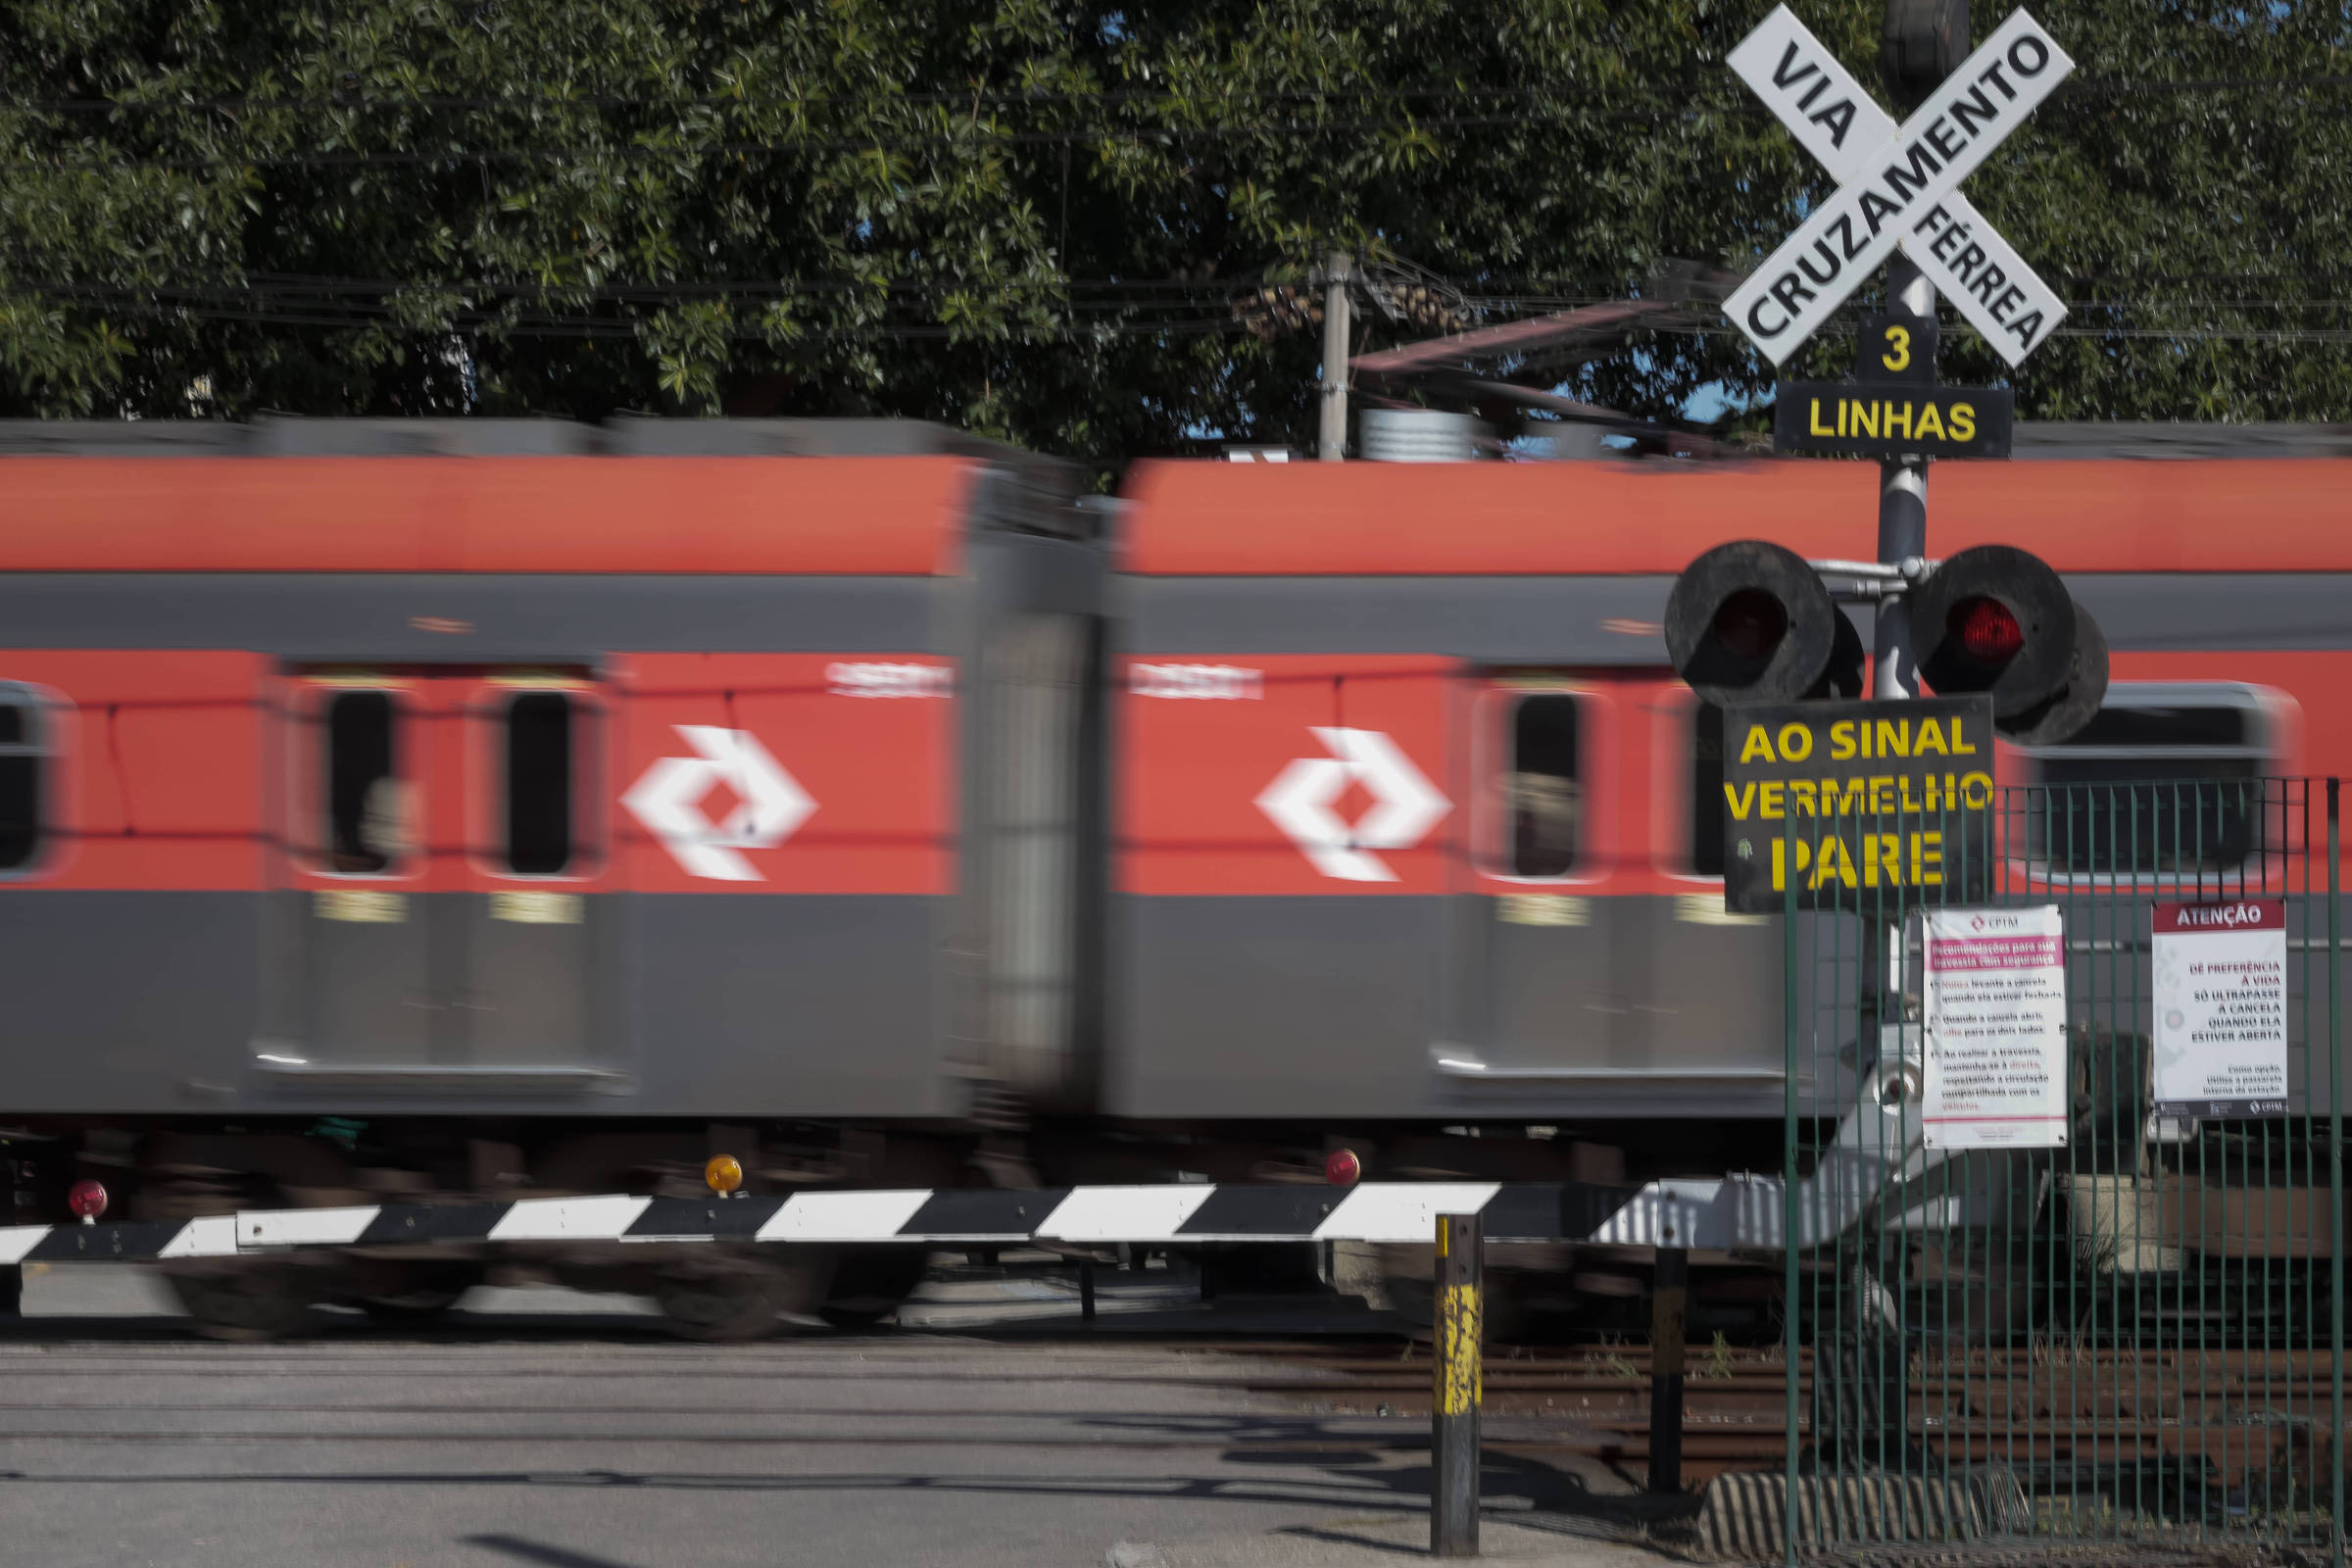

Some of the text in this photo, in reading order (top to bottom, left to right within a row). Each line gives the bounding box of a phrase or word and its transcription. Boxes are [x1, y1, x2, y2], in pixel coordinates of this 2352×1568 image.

[1771, 40, 1858, 150] VIA
[1747, 35, 2050, 340] CRUZAMENTO
[1913, 203, 2044, 352] FÉRREA
[1882, 325, 1911, 372] 3
[1810, 398, 1977, 442] LINHAS
[1740, 716, 1977, 764] AO SINAL
[1724, 771, 1994, 820] VERMELHO
[1771, 831, 1948, 893] PARE
[2177, 902, 2263, 928] ATENÇÃO
[2207, 959, 2280, 974] PREFERÊNCIA
[2253, 975, 2280, 987] VIDA
[2212, 988, 2280, 1002] ULTRAPASSE
[2230, 1002, 2280, 1014] CANCELA
[2191, 1029, 2281, 1044] ESTIVER ABERTA
[2208, 1015, 2281, 1029] QUANDO ELA
